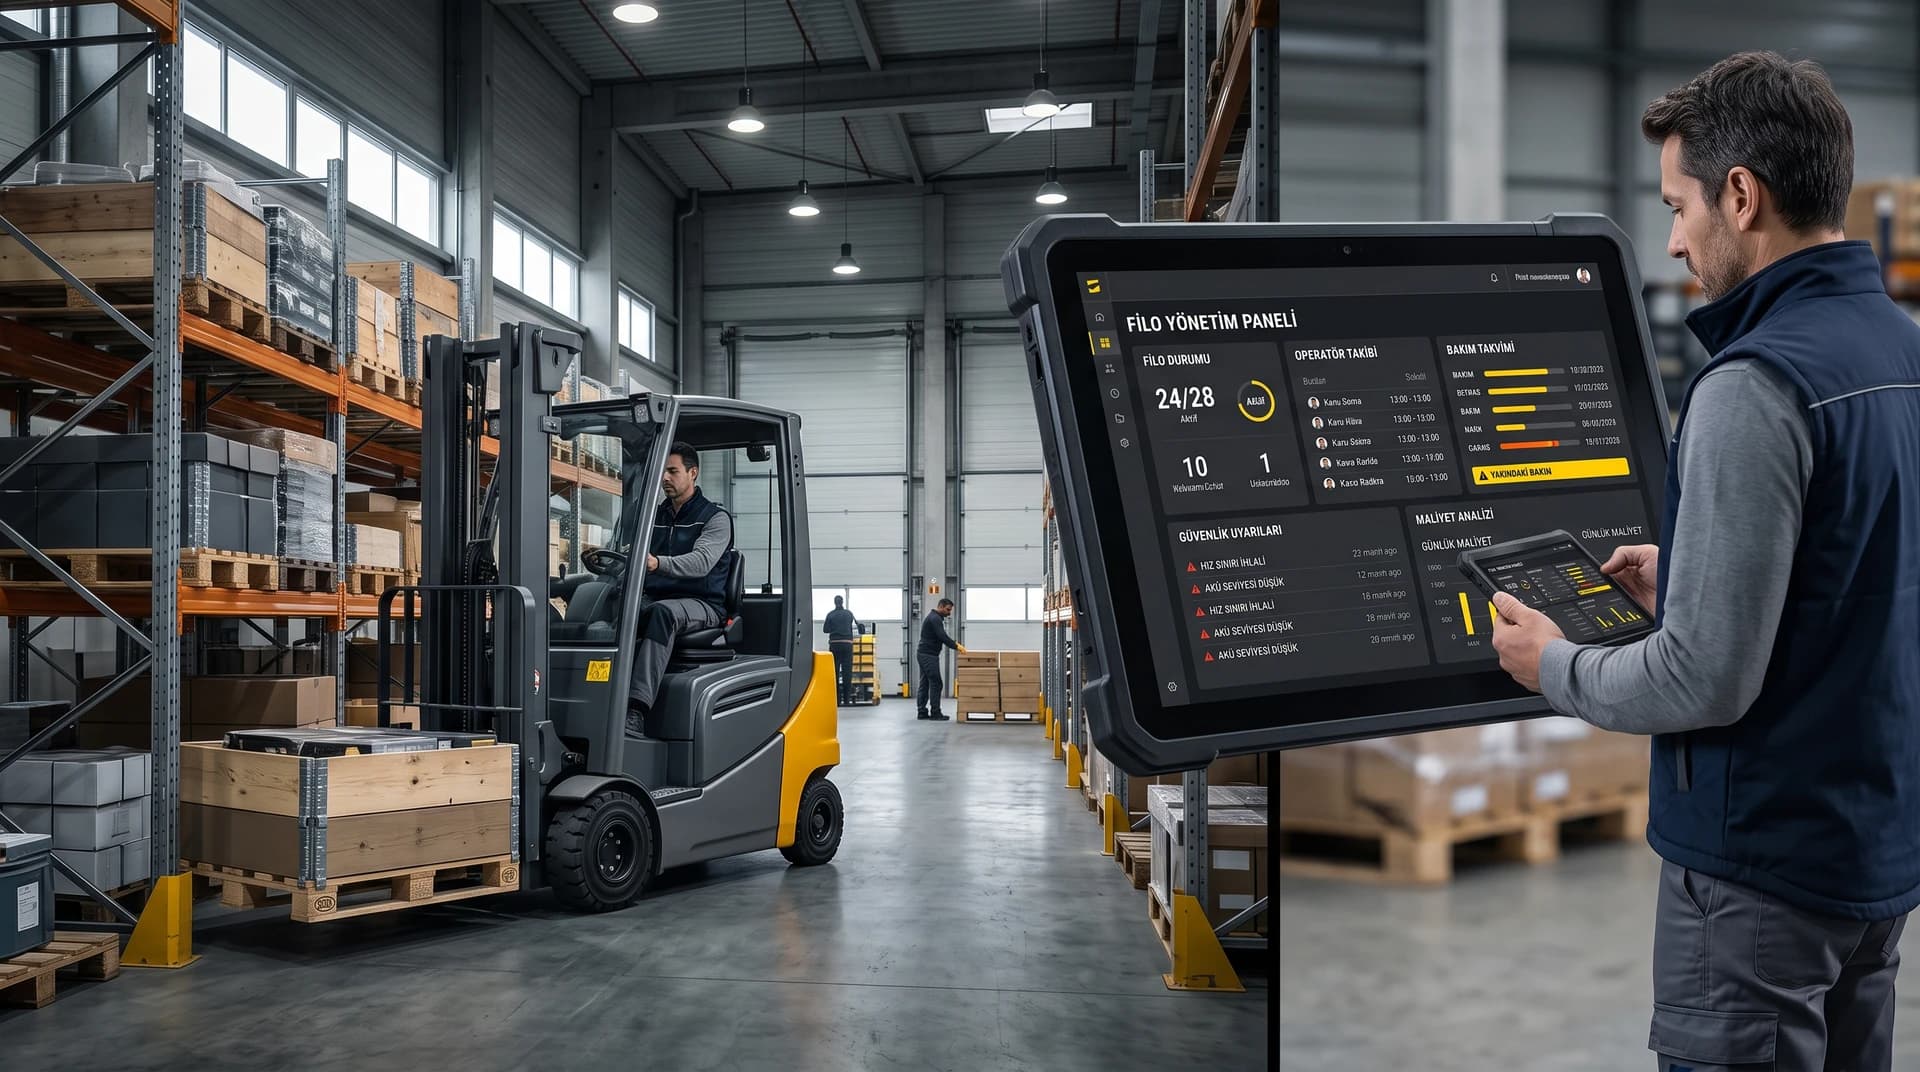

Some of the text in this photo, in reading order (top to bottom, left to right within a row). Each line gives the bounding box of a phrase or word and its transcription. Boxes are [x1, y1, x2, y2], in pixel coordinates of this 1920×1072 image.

[1126, 308, 1298, 332] FİLO YÖNETİM PANELİ
[1294, 345, 1378, 360] OPERATÖR TAKİBİ
[1446, 341, 1515, 355] BAKIM TAKVİMİ
[1143, 353, 1211, 367] FİLO DURUMU
[1156, 386, 1215, 410] 24/28
[1182, 456, 1208, 478] 10
[1260, 452, 1270, 473] 1
[1490, 467, 1528, 478] YAKINDAKİ
[1415, 507, 1494, 525] MALİYET ANALİZİ
[1179, 525, 1282, 542] GÜVENLİK UYARILARI
[1582, 524, 1642, 538] GÜNLÜK MALİYET
[1421, 535, 1492, 551] GÜNLÜK MALİYET
[1384, 548, 1397, 556] ago
[1200, 560, 1215, 570] HIZ
[1215, 559, 1239, 570] SINIRI
[1388, 569, 1402, 578] ago
[1393, 591, 1406, 599] ago
[1209, 606, 1224, 615] HIZ
[1225, 603, 1248, 614] SINIRI
[1398, 612, 1411, 620] ago
[1402, 633, 1415, 642] ago
